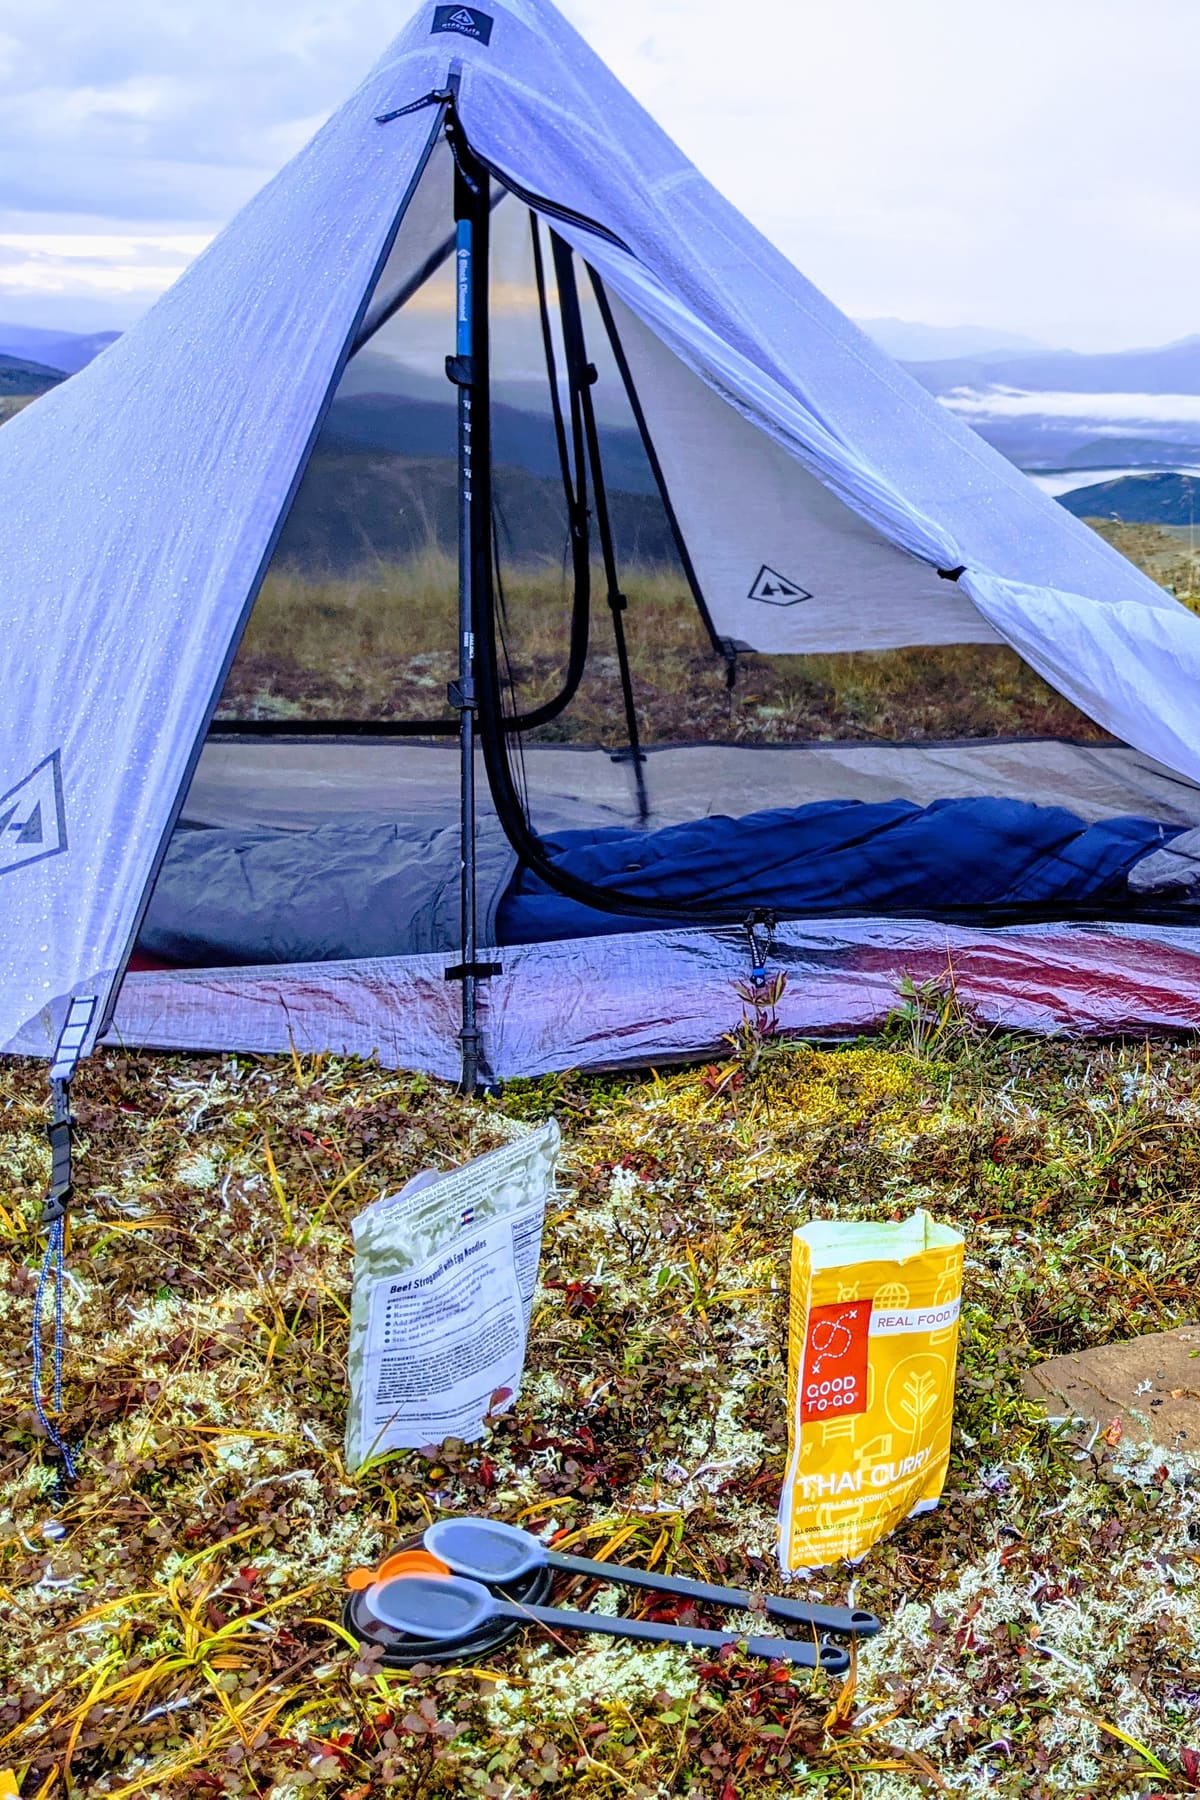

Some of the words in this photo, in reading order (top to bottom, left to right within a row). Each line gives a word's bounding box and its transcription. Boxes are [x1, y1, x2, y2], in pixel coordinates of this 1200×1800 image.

[458, 259, 469, 283] Black
[458, 283, 469, 322] Diamond
[390, 1281, 412, 1294] Beef
[414, 1263, 444, 1289] Stroganoff
[443, 1257, 454, 1271] with
[453, 1252, 464, 1264] Egg
[464, 1239, 487, 1258] Noodles
[877, 1316, 913, 1328] REAL
[806, 1376, 856, 1398] GOOD
[796, 1469, 863, 1499] THAI
[870, 1447, 932, 1487] CURRY
[795, 1503, 818, 1514] SPICY
[819, 1500, 853, 1511] YELLOW
[854, 1491, 888, 1504] COCONUT
[794, 1527, 804, 1536] ALL
